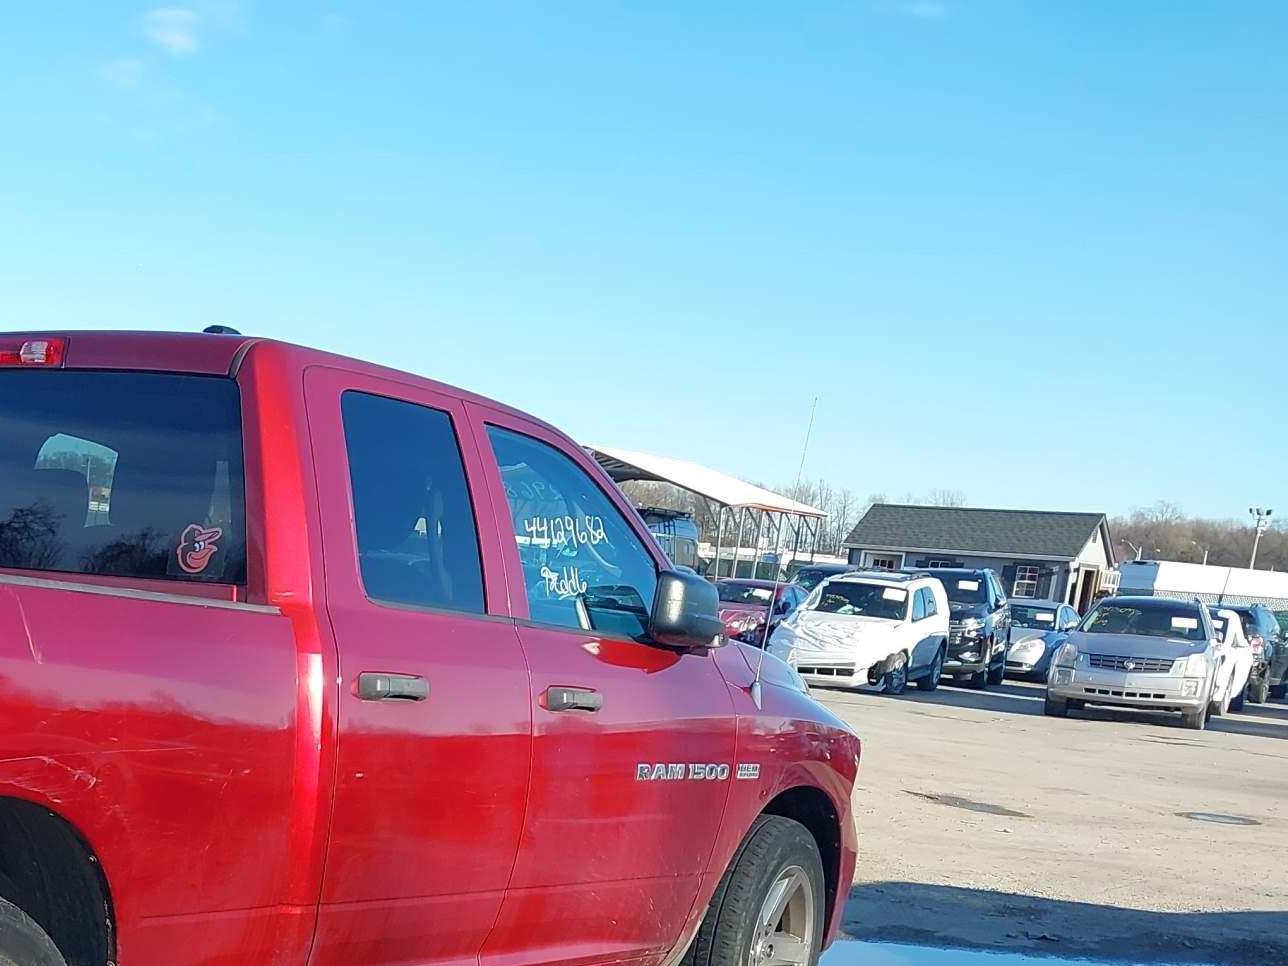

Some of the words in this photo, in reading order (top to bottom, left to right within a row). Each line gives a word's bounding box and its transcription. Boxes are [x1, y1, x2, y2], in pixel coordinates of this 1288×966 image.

[524, 515, 609, 548] 44129682
[636, 763, 685, 780] RAM
[688, 763, 730, 779] 1500
